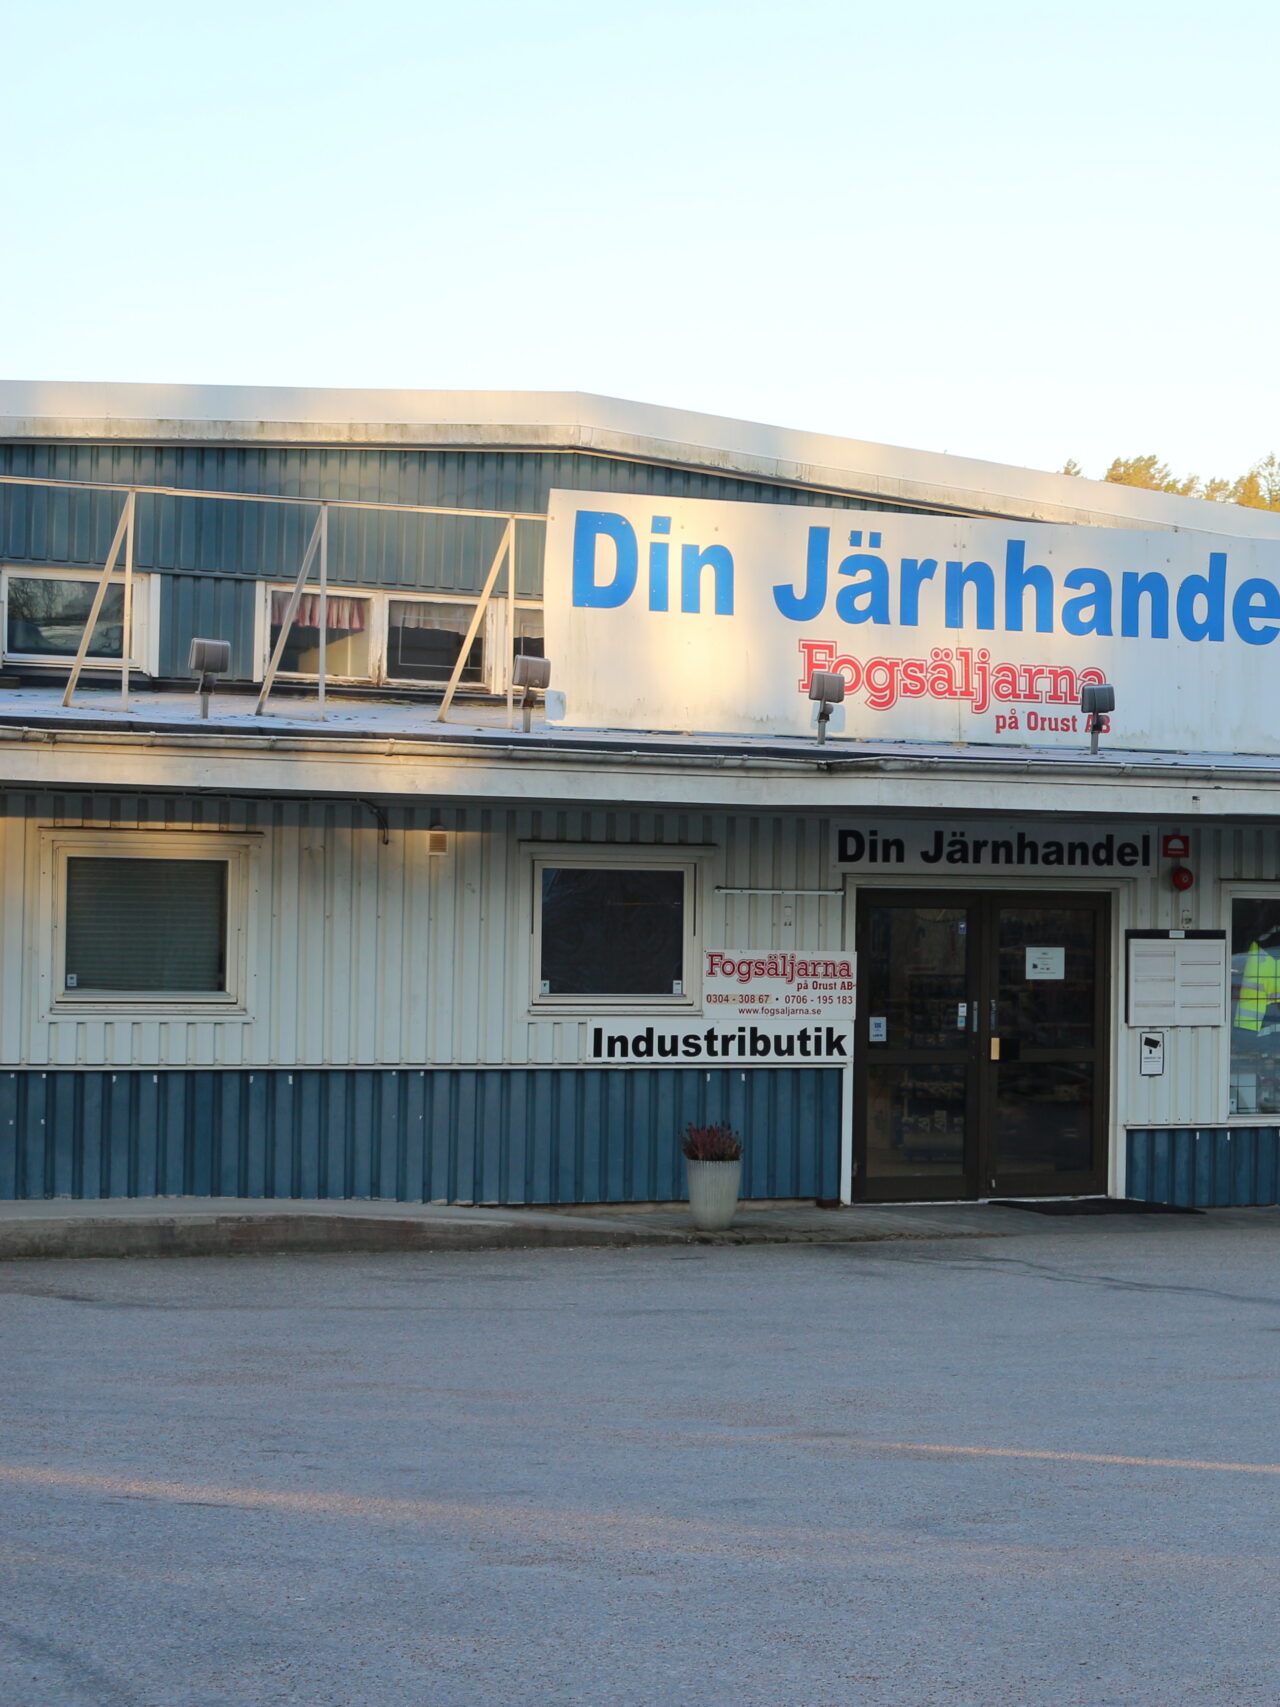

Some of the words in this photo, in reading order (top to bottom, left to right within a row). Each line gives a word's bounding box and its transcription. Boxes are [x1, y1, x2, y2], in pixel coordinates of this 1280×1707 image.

[571, 509, 735, 616] Din
[995, 709, 1019, 734] på
[1027, 711, 1078, 732] Orust
[838, 829, 905, 863] Din
[920, 830, 1150, 867] Järnhandel
[706, 952, 853, 984] Fogsäljarna
[706, 994, 729, 1004] 0304
[739, 994, 755, 1004] 308
[758, 994, 770, 1004] 67
[785, 995, 808, 1004] 0706
[817, 995, 833, 1004] 195
[837, 995, 853, 1005] 183
[796, 980, 809, 992] på
[812, 981, 837, 991] Orust
[840, 981, 853, 991] AB
[738, 1006, 822, 1017] www.fogsaljarna.se
[593, 1026, 848, 1058] Industributik
